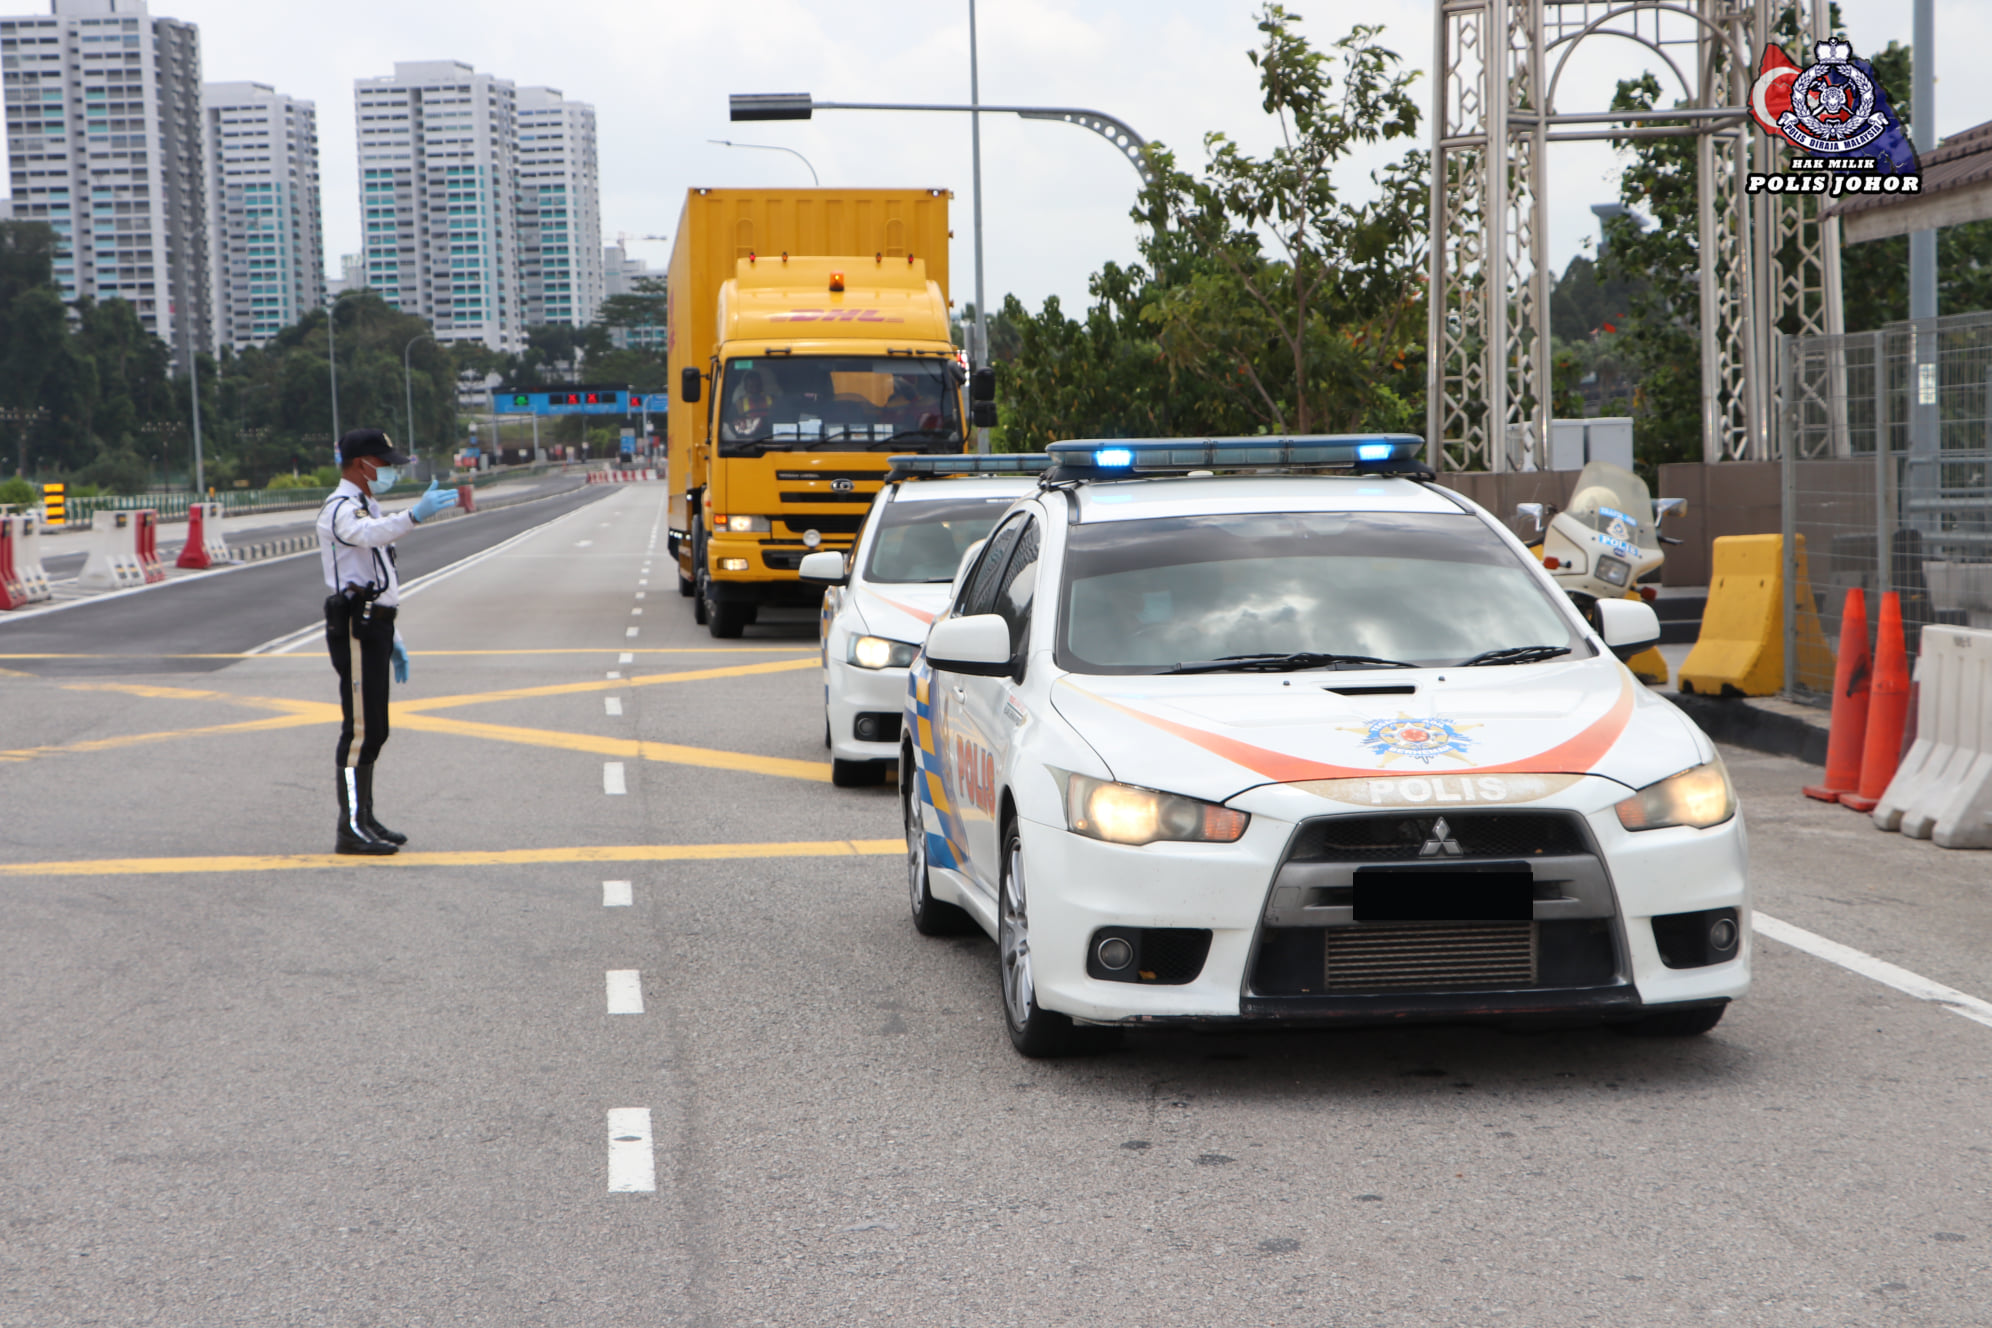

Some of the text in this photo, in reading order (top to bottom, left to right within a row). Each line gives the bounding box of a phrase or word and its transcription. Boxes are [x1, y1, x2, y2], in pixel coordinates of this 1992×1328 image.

[788, 308, 885, 322] DHL
[1601, 534, 1637, 556] POLIS
[956, 733, 996, 821] POLIS
[1369, 776, 1508, 804] POLIS
